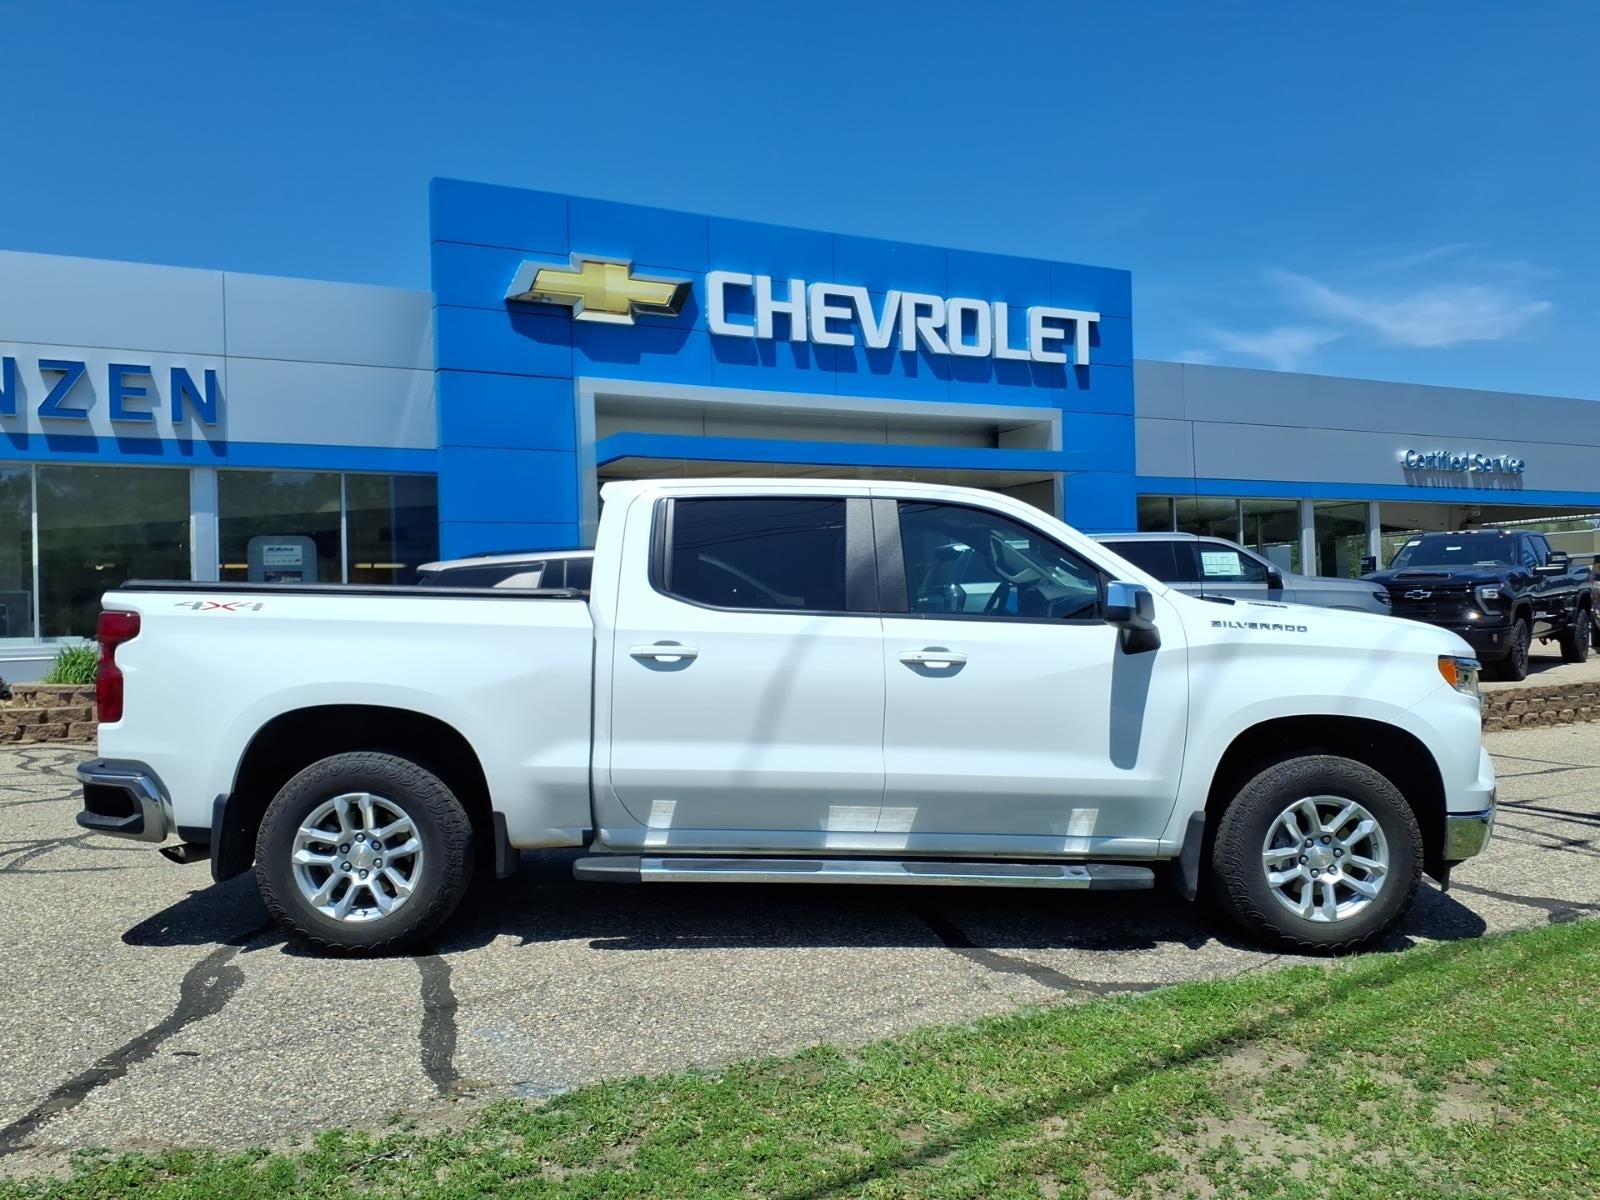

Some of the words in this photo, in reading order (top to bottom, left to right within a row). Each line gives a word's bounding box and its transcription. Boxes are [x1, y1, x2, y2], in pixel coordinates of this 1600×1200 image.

[705, 270, 1100, 365] CHEVROLET
[1401, 449, 1470, 471] Certified
[1473, 453, 1525, 474] Service
[1211, 620, 1308, 633] SILVERADO
